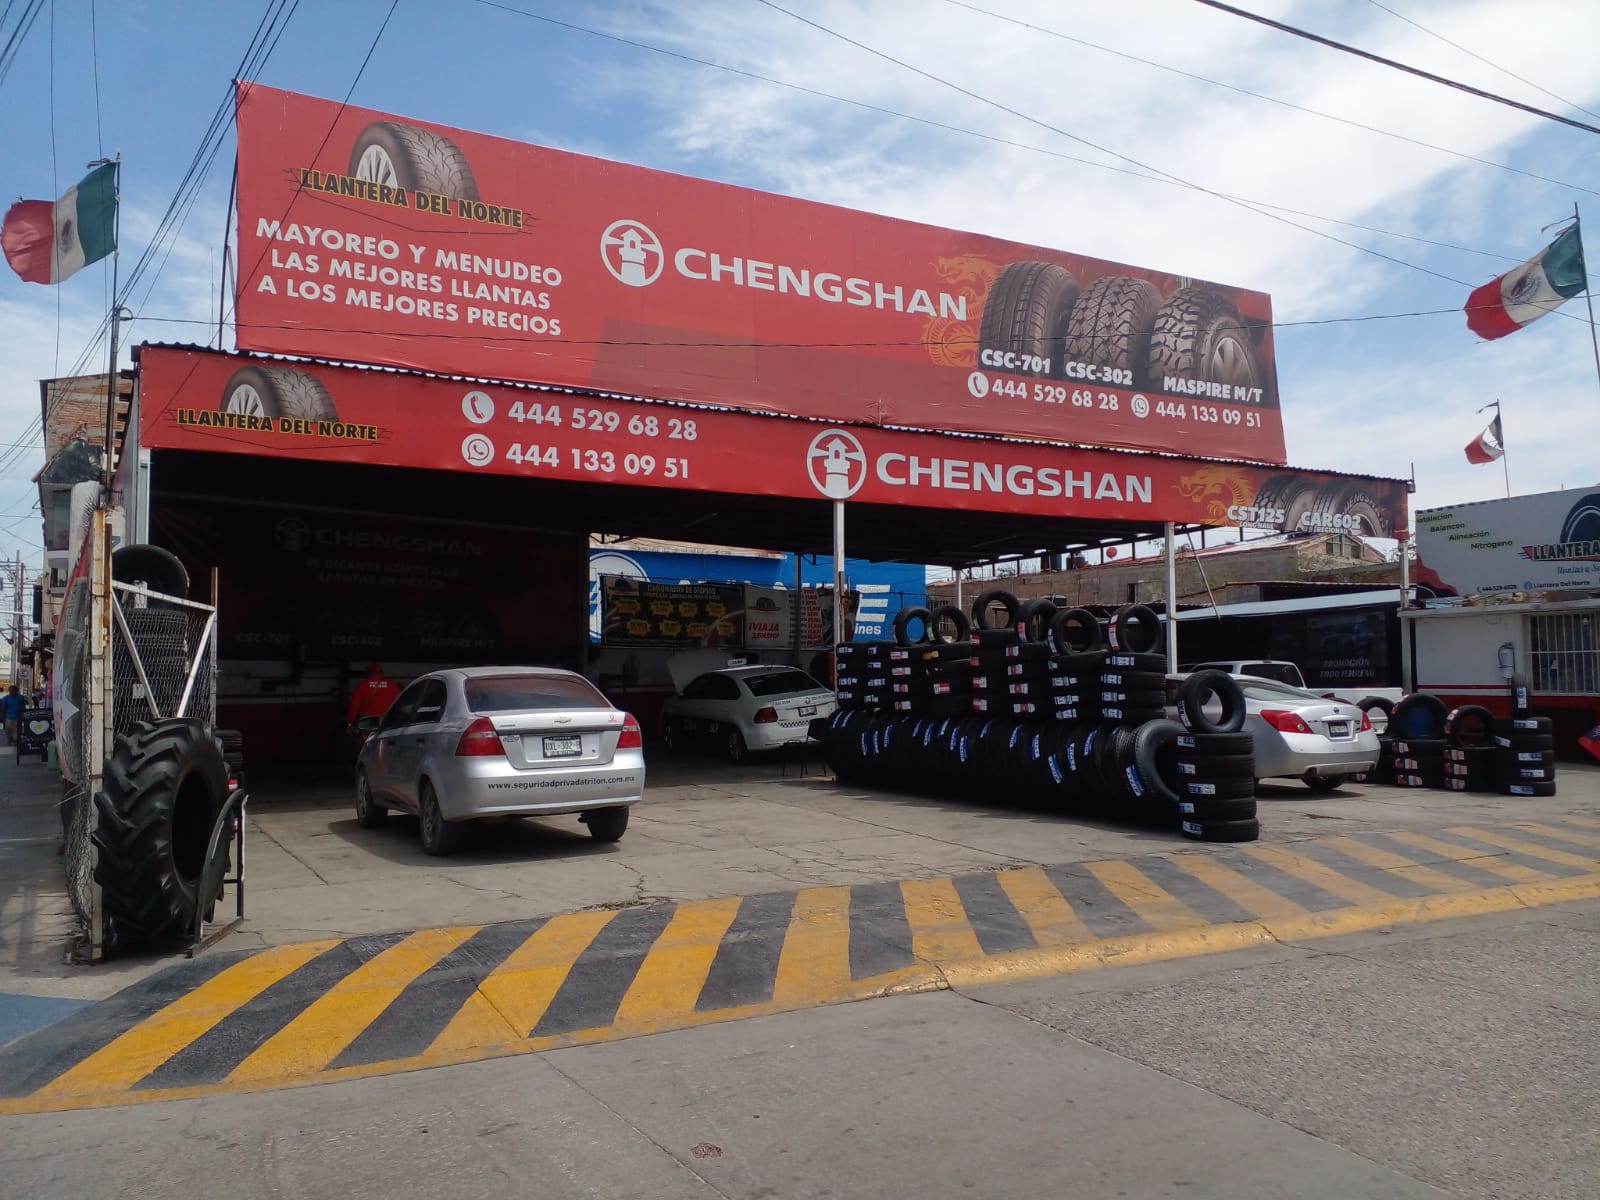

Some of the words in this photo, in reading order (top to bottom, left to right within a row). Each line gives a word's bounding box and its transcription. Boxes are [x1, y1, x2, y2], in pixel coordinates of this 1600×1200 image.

[301, 168, 408, 208] LLANTERA
[416, 192, 452, 216] DEL
[458, 200, 522, 228] NORTE
[256, 218, 400, 260] MAYOREO
[408, 244, 426, 264] Y
[435, 249, 562, 287] MENUDEO
[272, 249, 320, 274] LAS
[329, 260, 442, 294] MEJORES
[451, 278, 550, 310] LLANTAS
[674, 248, 967, 321] CHENGSHAN
[257, 275, 277, 294] A
[287, 279, 336, 303] LOS
[345, 289, 458, 322] MEJORES
[467, 306, 561, 336] PRECIOS
[981, 348, 1050, 374] CSC-701
[1065, 361, 1133, 386] CSC-302
[992, 379, 1028, 400] 444
[1034, 384, 1066, 404] 529
[1072, 390, 1092, 408] 68
[1098, 392, 1120, 411] 28
[1164, 376, 1231, 400] MASPIRE
[1234, 384, 1263, 403] M/T
[177, 408, 274, 432] LLANTERA
[280, 417, 312, 436] DEL
[318, 420, 378, 441] NORTE
[508, 401, 562, 427] 444
[571, 408, 620, 432] 529
[628, 414, 659, 437] 68
[668, 418, 698, 441] 28
[1156, 400, 1186, 420] 444
[1191, 405, 1218, 423] 133
[1222, 408, 1242, 425] 09
[1246, 412, 1262, 428] 51
[506, 442, 560, 468] 444
[571, 448, 616, 473] 133
[624, 453, 656, 476] 09
[664, 458, 688, 479] 51
[876, 452, 1152, 504] CHENGSHAN
[1228, 506, 1284, 524] CST125
[1300, 511, 1361, 530] CAR602
[1430, 522, 1465, 532] Balanceo
[1533, 540, 1600, 560] LLANTERA
[854, 624, 882, 634] ines
[488, 776, 636, 790] www.seguridadprivadatriton.com.mx
